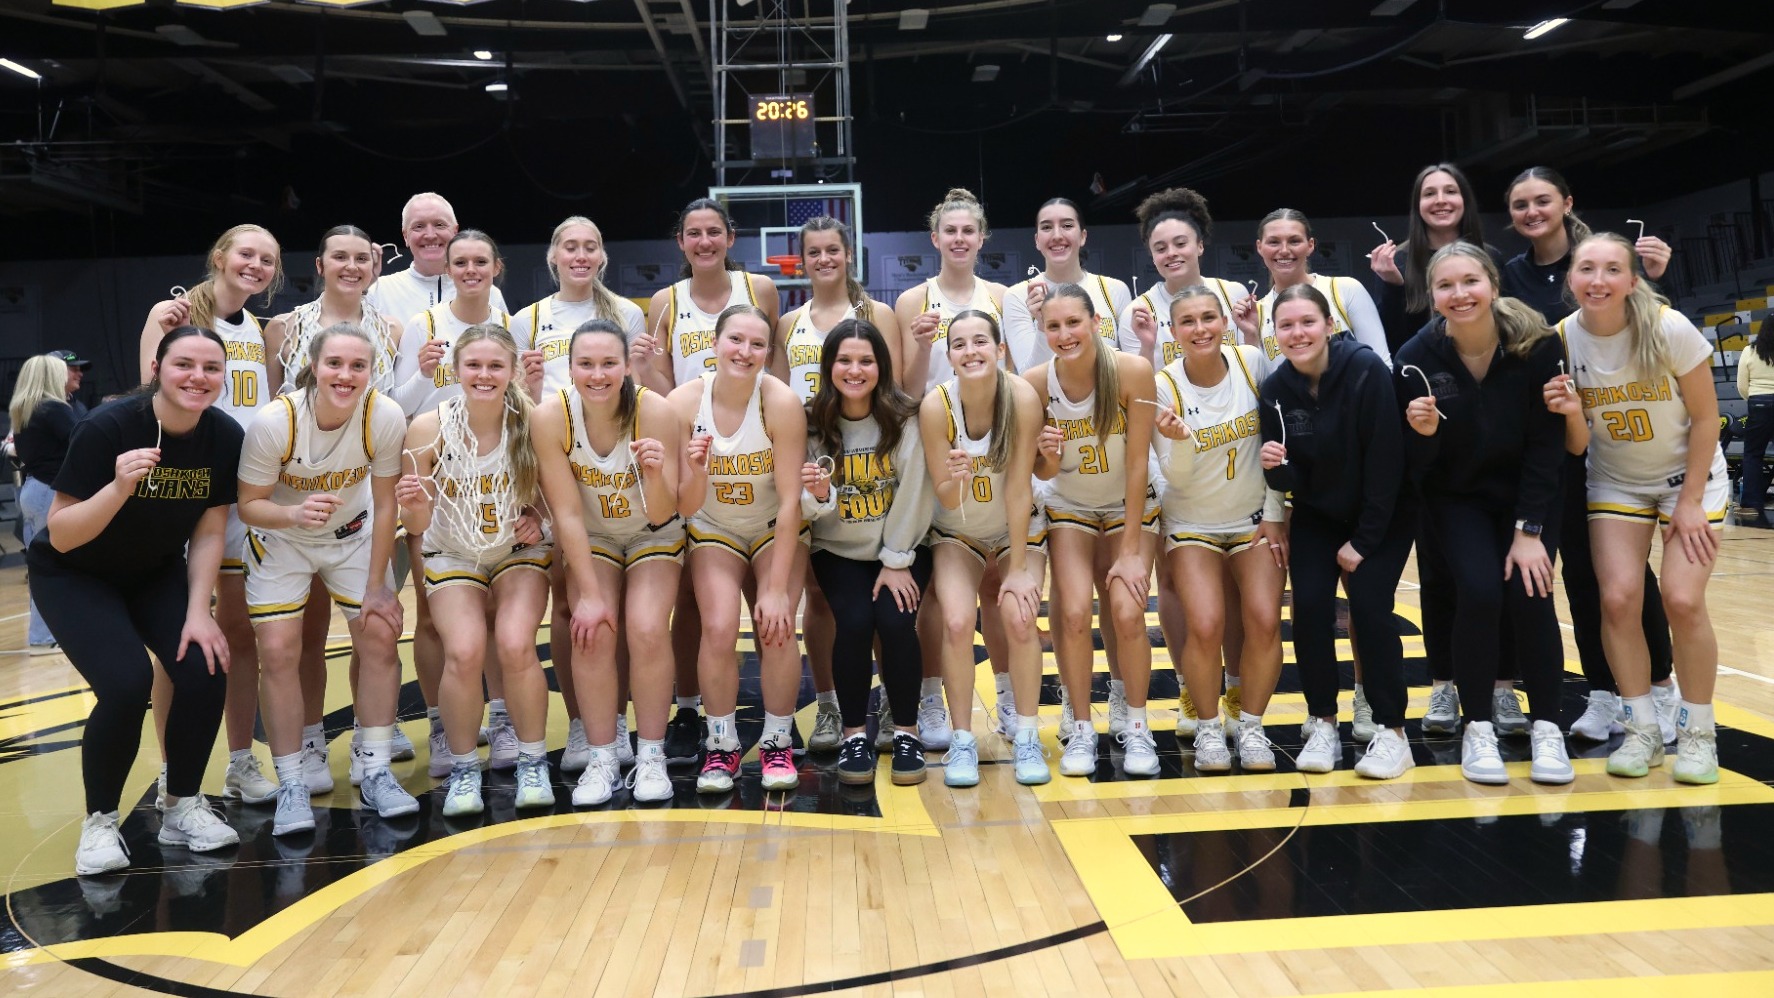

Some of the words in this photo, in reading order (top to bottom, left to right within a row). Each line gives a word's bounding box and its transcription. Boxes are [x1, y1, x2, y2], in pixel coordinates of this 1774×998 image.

[756, 101, 808, 120] 20:26
[231, 369, 258, 407] 10
[1576, 376, 1672, 409] SHKOSH
[1602, 408, 1654, 442] 20
[708, 447, 775, 476] HKOSH
[1078, 444, 1109, 474] 21
[1226, 447, 1237, 480] 1
[712, 482, 754, 505] 23
[972, 475, 993, 503] 0
[598, 493, 631, 518] 12
